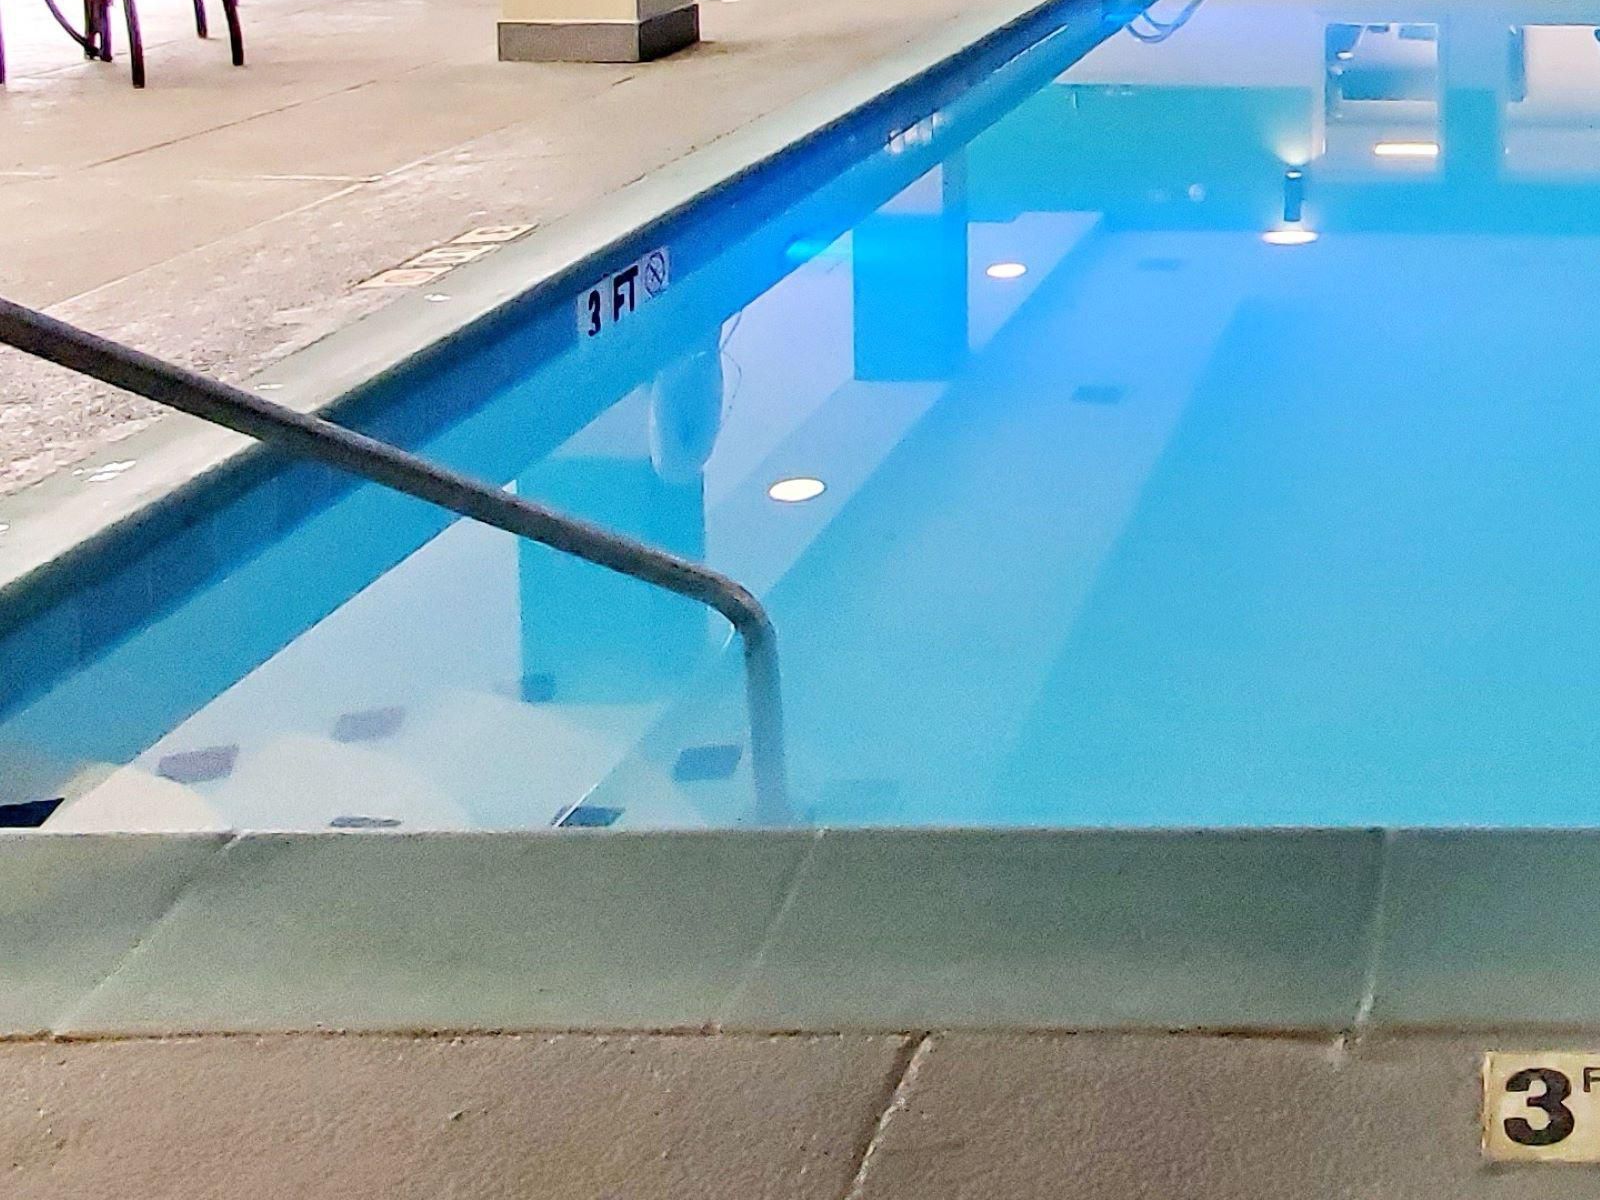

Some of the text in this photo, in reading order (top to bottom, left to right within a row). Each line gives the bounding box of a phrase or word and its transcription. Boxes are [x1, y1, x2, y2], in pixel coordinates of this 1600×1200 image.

[588, 265, 639, 337] 3 FT
[1504, 1068, 1575, 1146] 3
